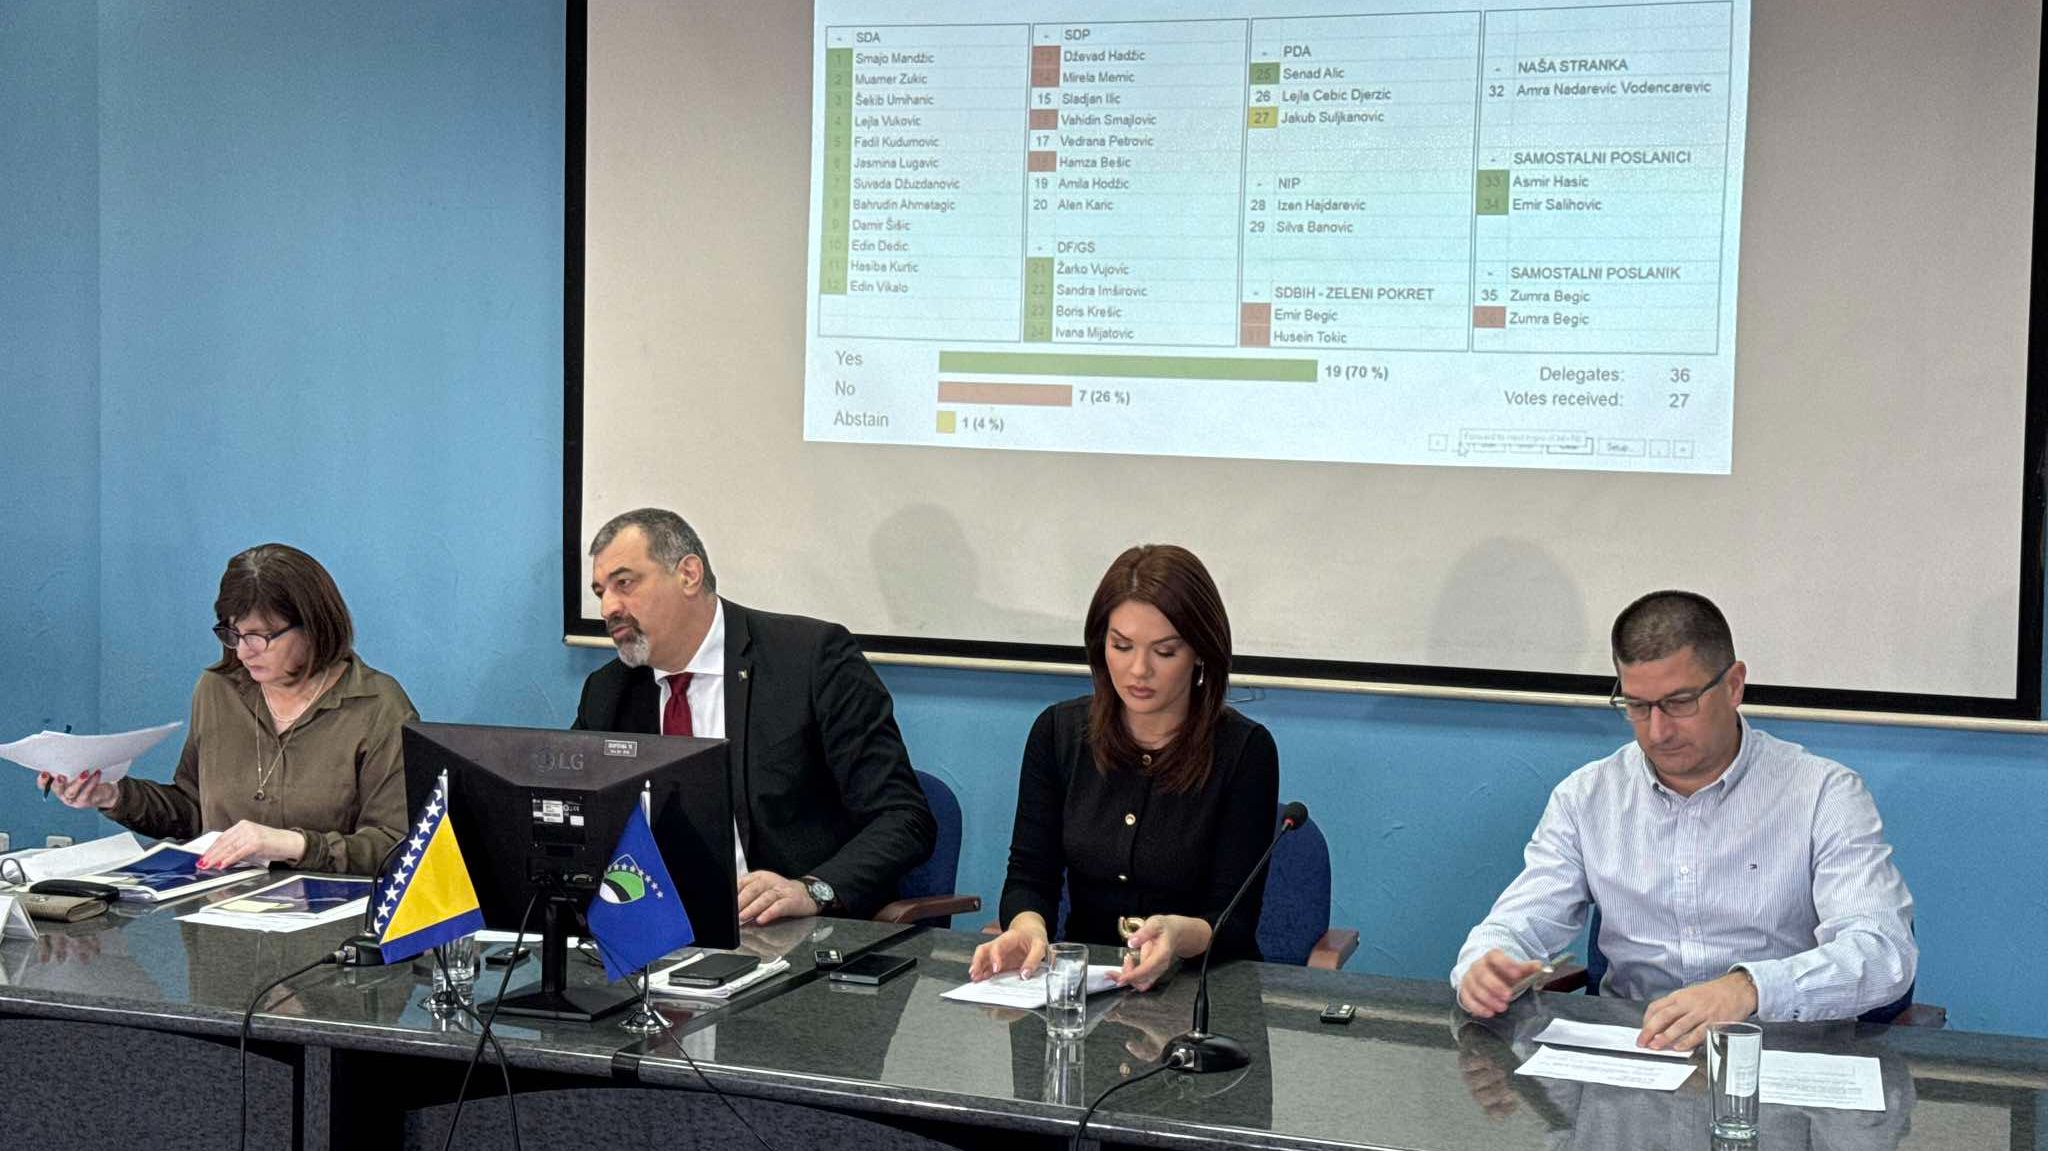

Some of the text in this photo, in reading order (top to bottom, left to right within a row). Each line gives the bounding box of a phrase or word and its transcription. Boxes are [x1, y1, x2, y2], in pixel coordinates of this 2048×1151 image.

[856, 32, 880, 43] SDA
[1065, 29, 1090, 40] SDP
[1064, 51, 1104, 62] Dževad
[1284, 46, 1311, 57] PDA
[856, 54, 888, 65] Smajo
[1519, 58, 1628, 73] NAŠA STRANKA
[855, 75, 896, 84] Muamer
[1063, 73, 1095, 83] Mirela
[1256, 69, 1271, 80] 25
[1283, 68, 1320, 79] Senad
[1489, 85, 1504, 97] 32
[1517, 85, 1550, 96] Amra
[855, 94, 884, 106] Šekib
[1039, 94, 1051, 104] 15
[1062, 94, 1103, 107] Sladjan
[1256, 91, 1270, 102] 26
[1282, 91, 1309, 104] Lejla
[855, 116, 879, 129] Lejla
[1061, 116, 1100, 125] Vahidin
[1254, 112, 1269, 124] 27
[1281, 112, 1315, 124] Jakub
[854, 137, 879, 147] Fadil
[1037, 136, 1049, 146] 17
[1060, 136, 1105, 146] Vedrana
[854, 158, 896, 168] Jasmina
[1060, 158, 1097, 168] Hamza
[1514, 151, 1691, 164] SAMOSTALNI POSLANICI
[854, 179, 891, 189] Suvada
[1058, 179, 1089, 189] Amila
[1279, 178, 1300, 189] NIP
[1513, 177, 1549, 187] Asmir
[853, 200, 897, 210] Bahrudin
[1034, 200, 1047, 210] 20
[1058, 200, 1082, 210] Alen
[1250, 200, 1265, 210] 28
[1278, 200, 1302, 210] Izen
[1513, 199, 1541, 210] Emir
[853, 220, 883, 230] Damir
[1250, 221, 1264, 232] 29
[1277, 221, 1304, 232] Silva
[852, 241, 875, 251] Edin
[1058, 242, 1095, 253] DF/GS
[851, 261, 886, 271] Hasiba
[1057, 262, 1087, 275] Žarko
[1511, 267, 1681, 279] SAMOSTALNI POSLANIK
[851, 281, 874, 292] Edin
[877, 282, 908, 293] Vikalo
[1057, 285, 1095, 296] Sandra
[1275, 287, 1315, 299] SDBIH
[1326, 288, 1373, 299] ZELENI
[1377, 288, 1434, 300] POKRET
[1482, 290, 1498, 301] 35
[1510, 290, 1550, 301] Zumra
[1056, 306, 1084, 316] Boris
[1275, 309, 1301, 320] Emir
[1509, 313, 1549, 324] Zumra
[1056, 328, 1084, 338] Ivana
[1274, 331, 1313, 342] Husein
[835, 351, 863, 366] Yes
[1325, 365, 1388, 381] 19 (70 %)
[1540, 367, 1690, 384] Delegates: 36
[835, 381, 855, 396] No
[1091, 390, 1111, 405] (26
[1115, 390, 1130, 406] %)
[1504, 391, 1690, 408] Votes received: 27
[834, 412, 889, 427] Abstain
[973, 416, 987, 431] (4
[989, 417, 1004, 432] %)
[560, 754, 584, 770] LG
